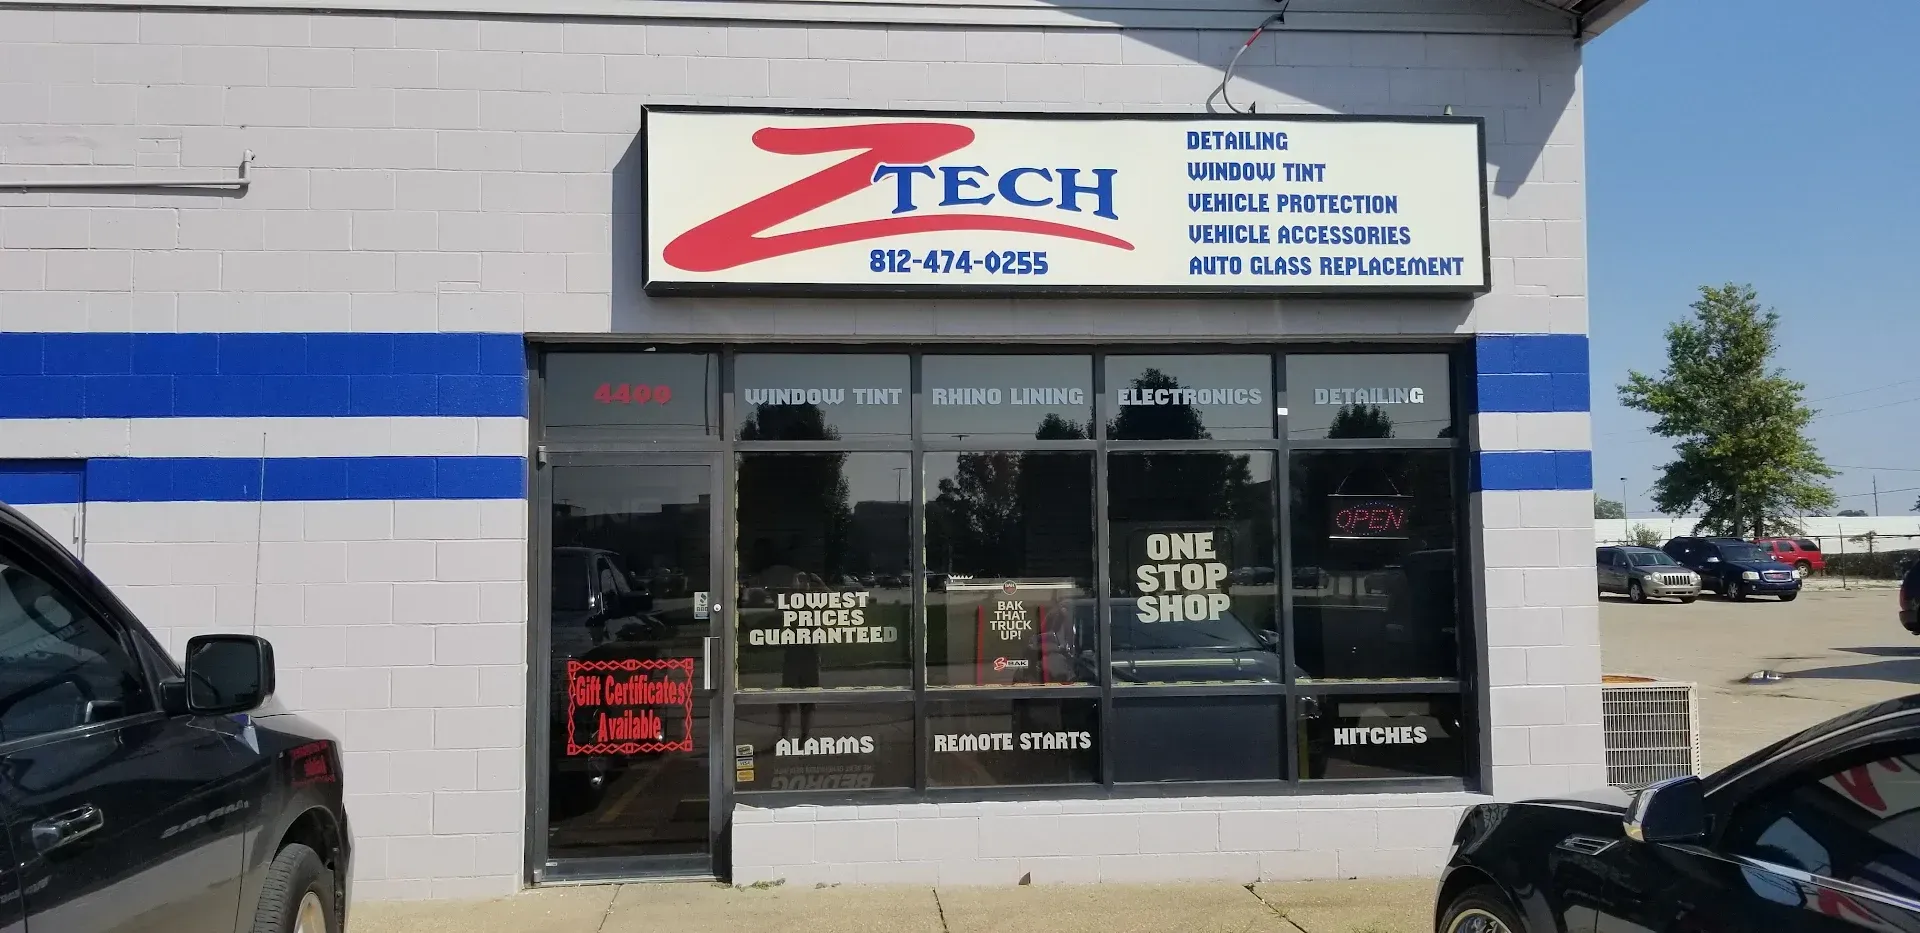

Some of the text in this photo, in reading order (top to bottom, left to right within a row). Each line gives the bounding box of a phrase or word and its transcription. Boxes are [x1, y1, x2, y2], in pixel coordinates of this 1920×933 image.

[1186, 130, 1289, 152] DETAILING
[1187, 161, 1326, 182] WINDOW TINT
[872, 164, 1119, 221] TECH
[1187, 193, 1398, 214] VEHICLE PROTECTION
[1188, 224, 1411, 246] VEHICLE ACCESSORIES
[869, 249, 1049, 276] 812-474-0255
[1189, 256, 1464, 277] AUTO GLASS REPLACEMENT
[744, 388, 903, 407] WINDOW TINT
[931, 388, 1085, 407] RHINO LINING
[1117, 388, 1263, 407] ELECTRONICS
[1313, 387, 1425, 406] DETAILING
[1335, 509, 1404, 530] OPEN
[1146, 532, 1217, 561] ONE
[1136, 562, 1228, 593] STOP
[777, 591, 870, 609] LOWEST
[997, 600, 1024, 611] BAK
[1136, 593, 1231, 624] SHOP
[783, 609, 865, 627] PRICES
[989, 620, 1033, 631] TRUCK
[993, 611, 1027, 621] THAT
[749, 627, 898, 646] GUARANTEED
[1000, 630, 1022, 641] UP!
[576, 674, 686, 706] Gift Certificates
[597, 709, 662, 743] Available
[1333, 725, 1428, 746] HITCHES
[775, 735, 875, 757] ALARMS
[933, 731, 1092, 752] REMOTE STARTS
